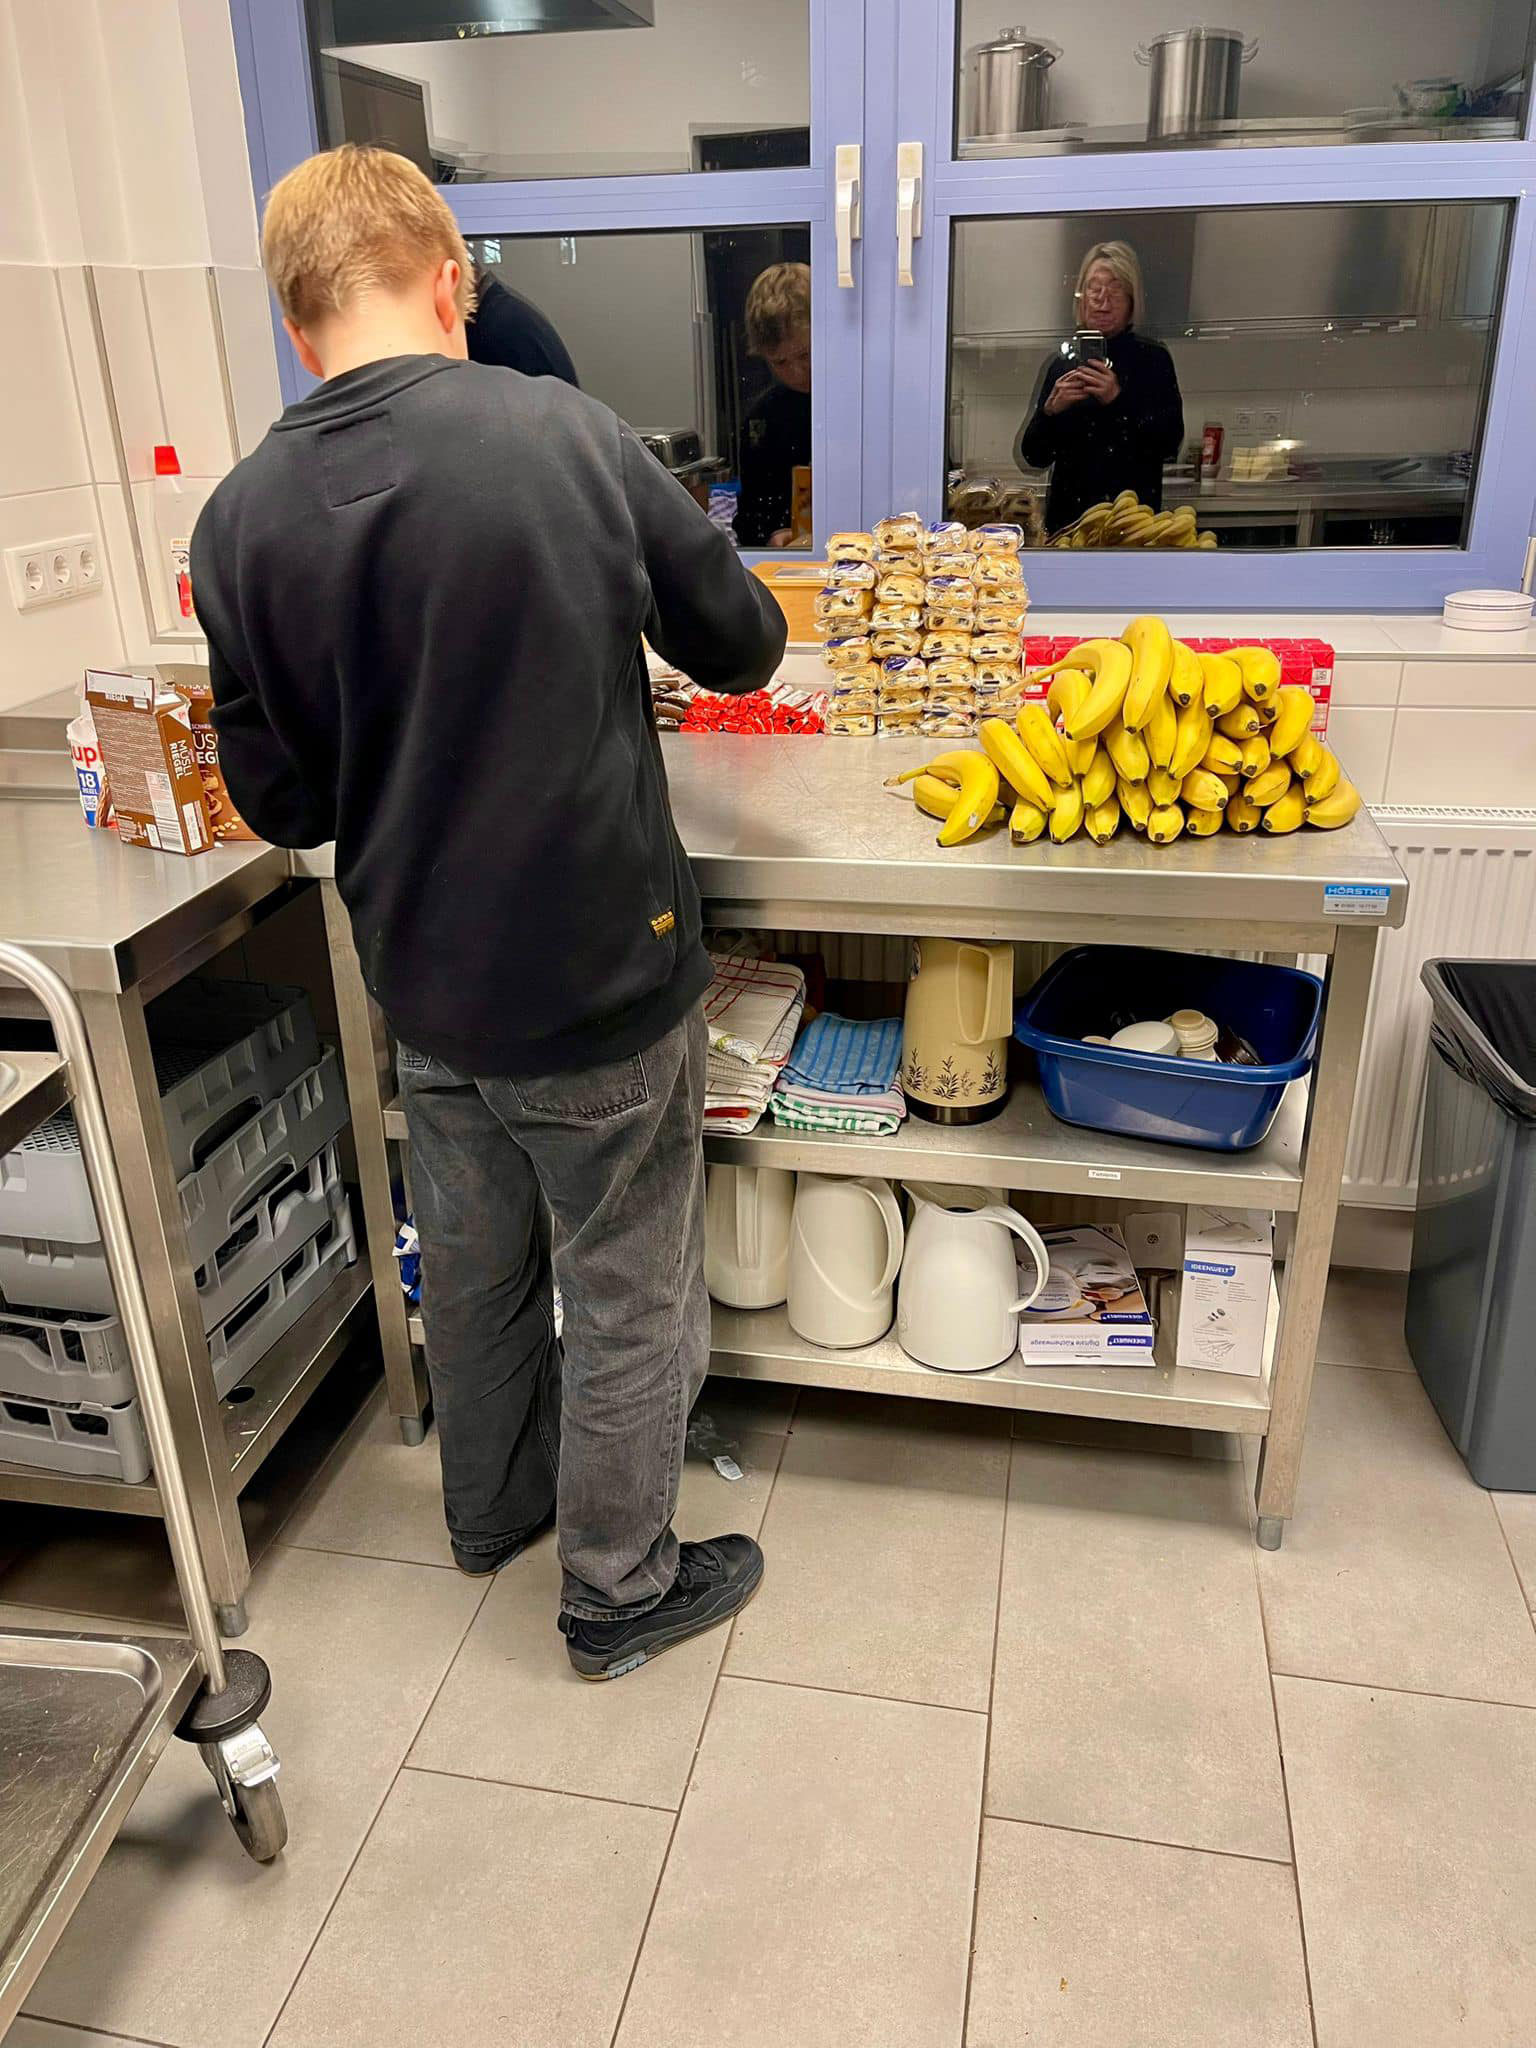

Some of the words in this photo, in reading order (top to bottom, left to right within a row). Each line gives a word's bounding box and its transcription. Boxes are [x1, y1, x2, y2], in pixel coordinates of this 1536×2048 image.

[169, 742, 184, 780] RIEGEL
[79, 772, 97, 788] 18
[1327, 886, 1388, 896] HÖRSTKE
[1190, 1263, 1229, 1274] IDEENWELT
[1112, 1337, 1147, 1345] IDEENWELT
